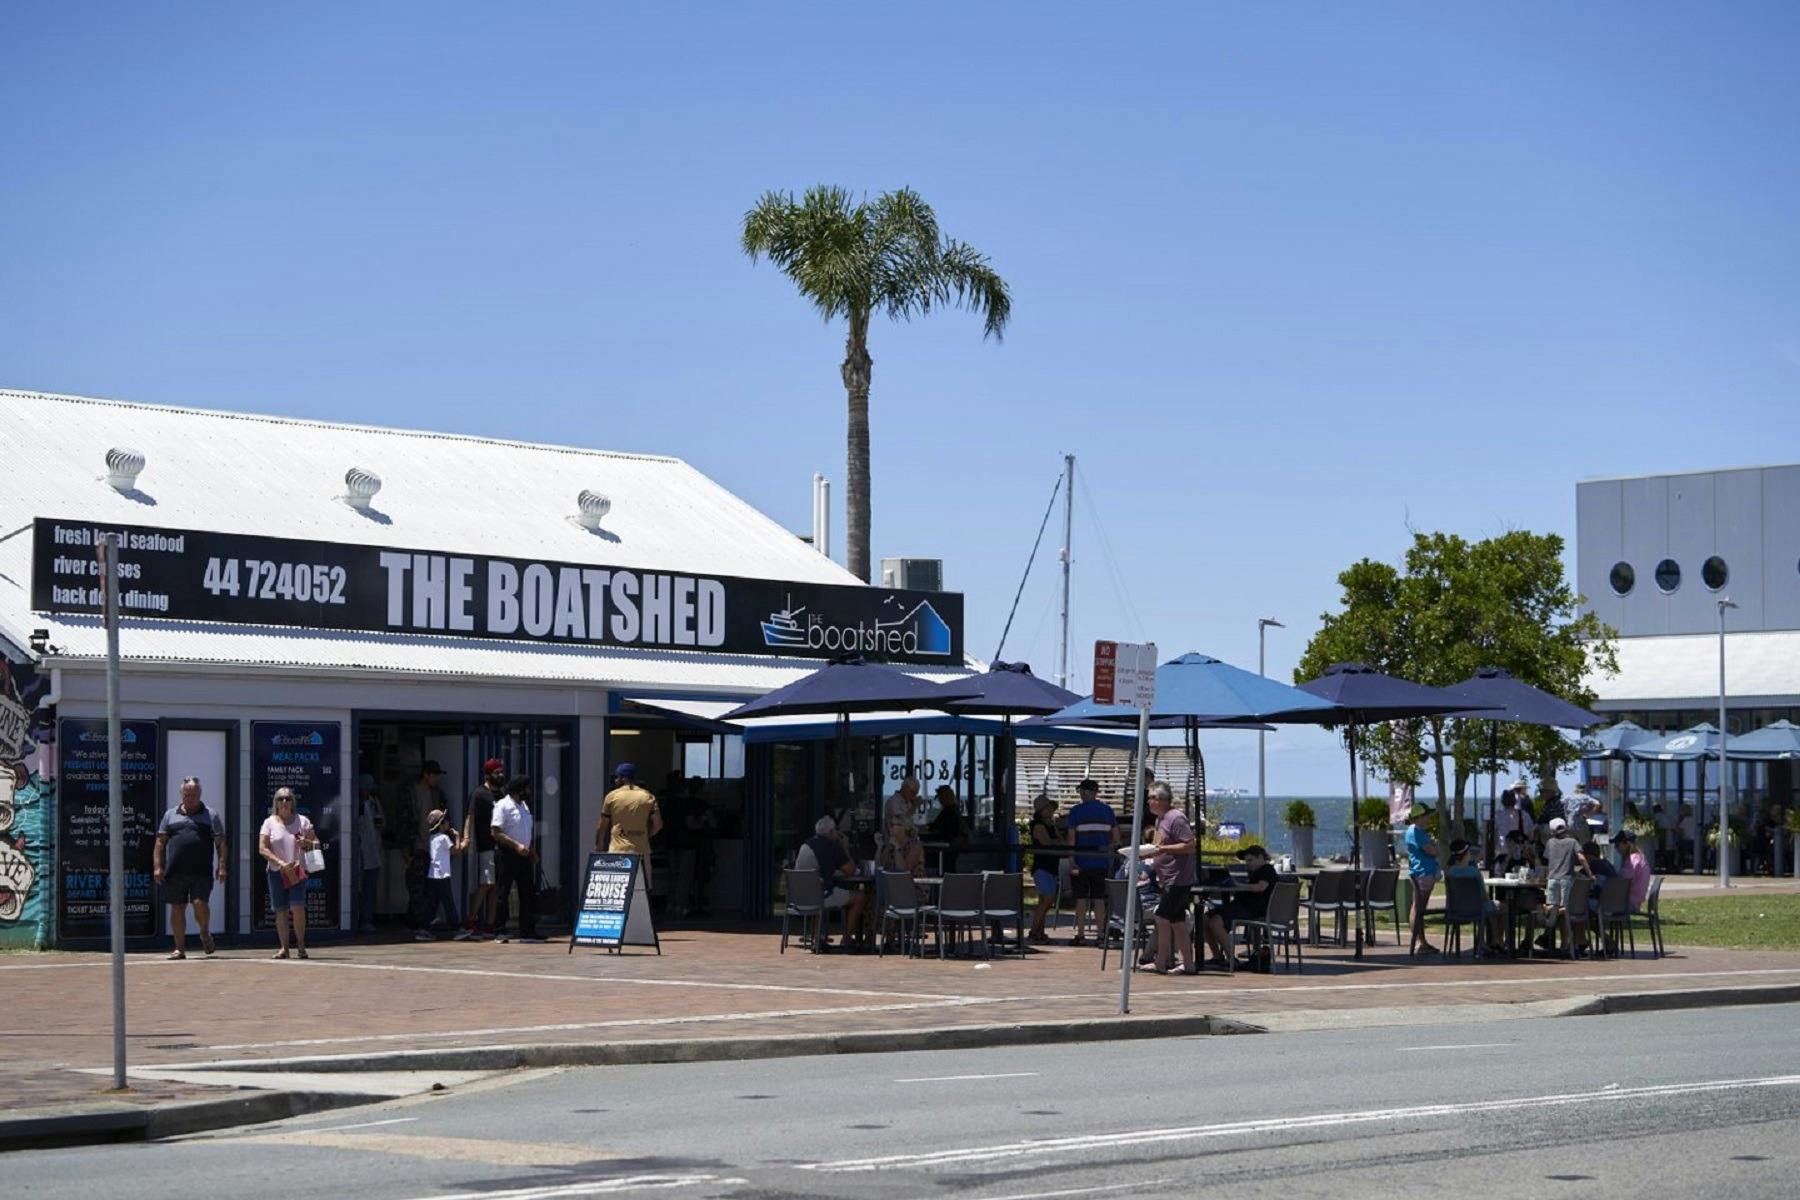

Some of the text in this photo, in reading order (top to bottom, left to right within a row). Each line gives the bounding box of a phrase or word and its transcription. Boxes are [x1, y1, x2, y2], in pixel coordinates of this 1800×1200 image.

[54, 525, 184, 553] fresh loal seafood
[54, 555, 141, 579] river cses
[203, 557, 347, 604] 44 724052
[53, 585, 169, 611] back dek dining
[379, 551, 725, 647] THE BOATSHED
[808, 613, 918, 654] boatshed
[66, 874, 103, 889] RIVER
[586, 882, 629, 899] CRUISE
